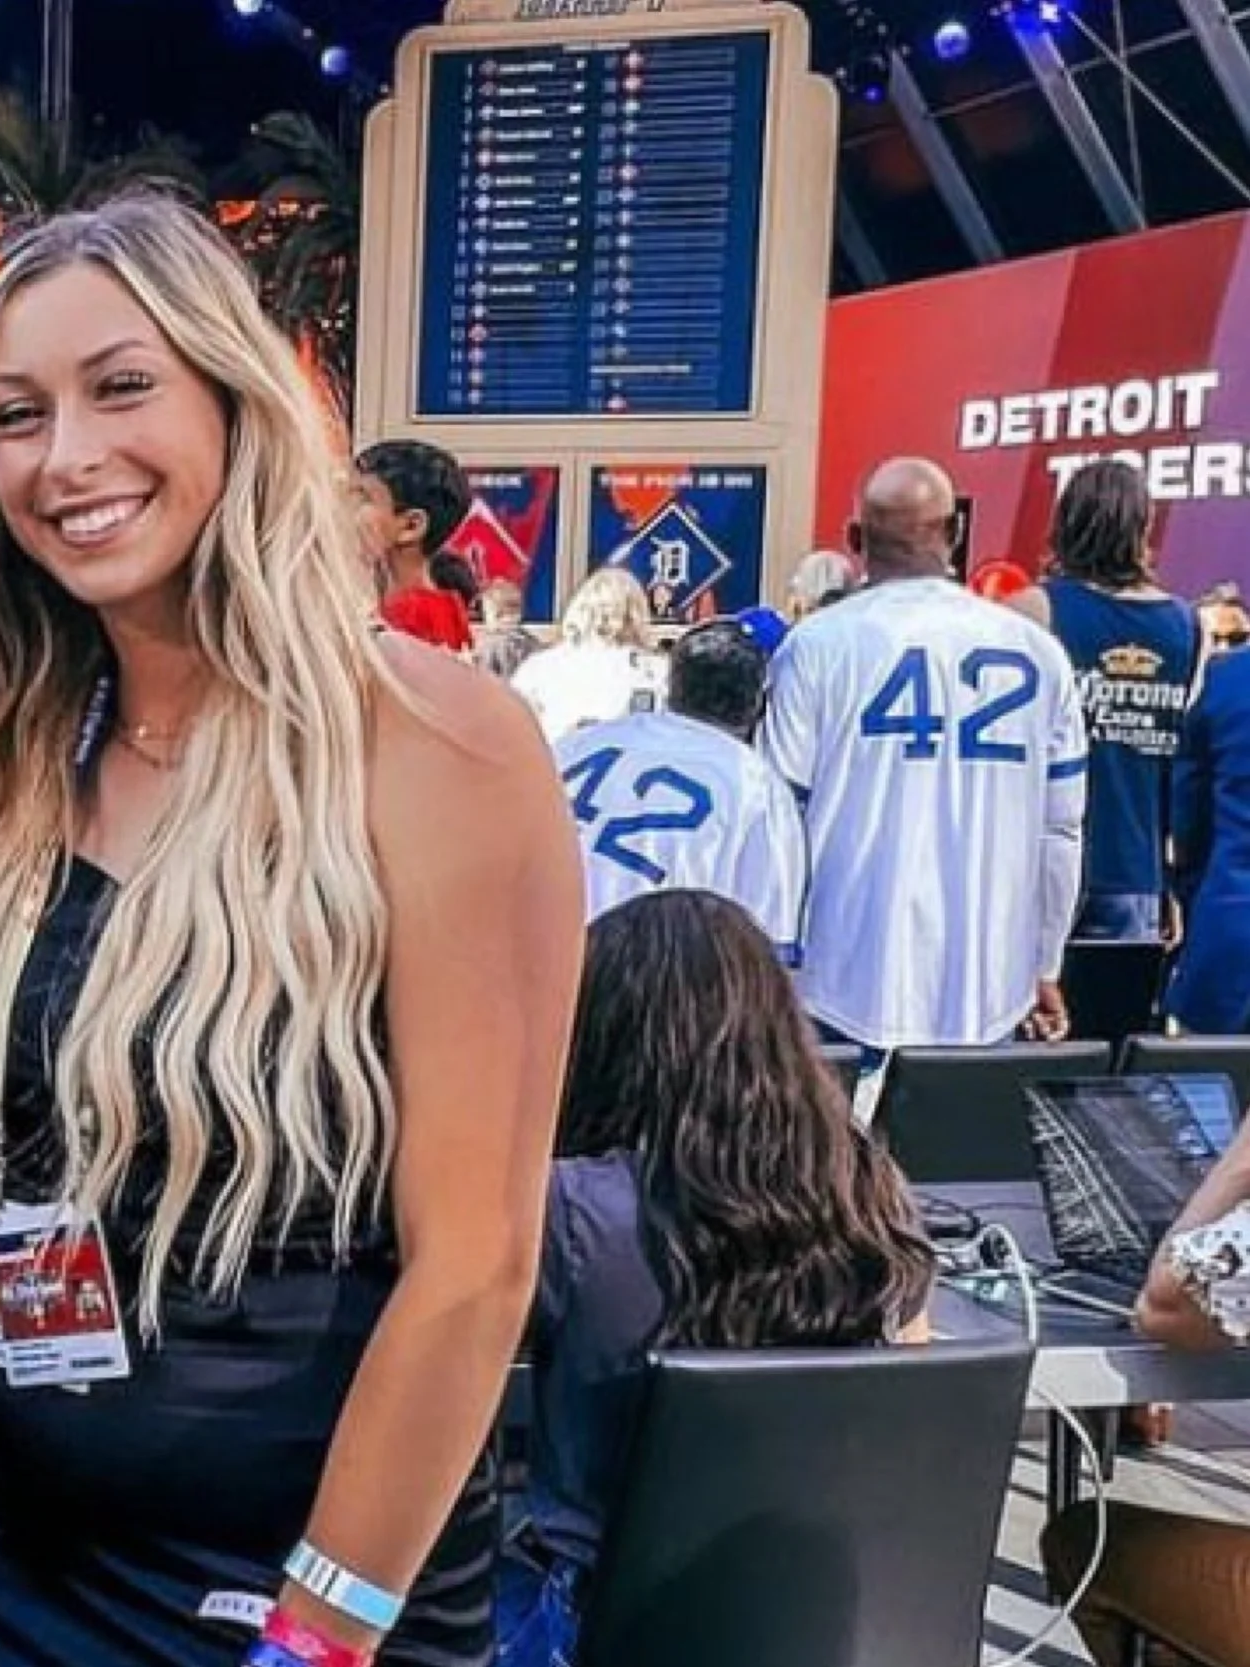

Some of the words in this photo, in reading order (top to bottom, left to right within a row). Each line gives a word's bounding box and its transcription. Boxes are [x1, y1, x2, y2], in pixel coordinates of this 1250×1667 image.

[959, 372, 1219, 449] DETROIT
[1047, 442, 1250, 499] TER
[860, 647, 1040, 759] 42
